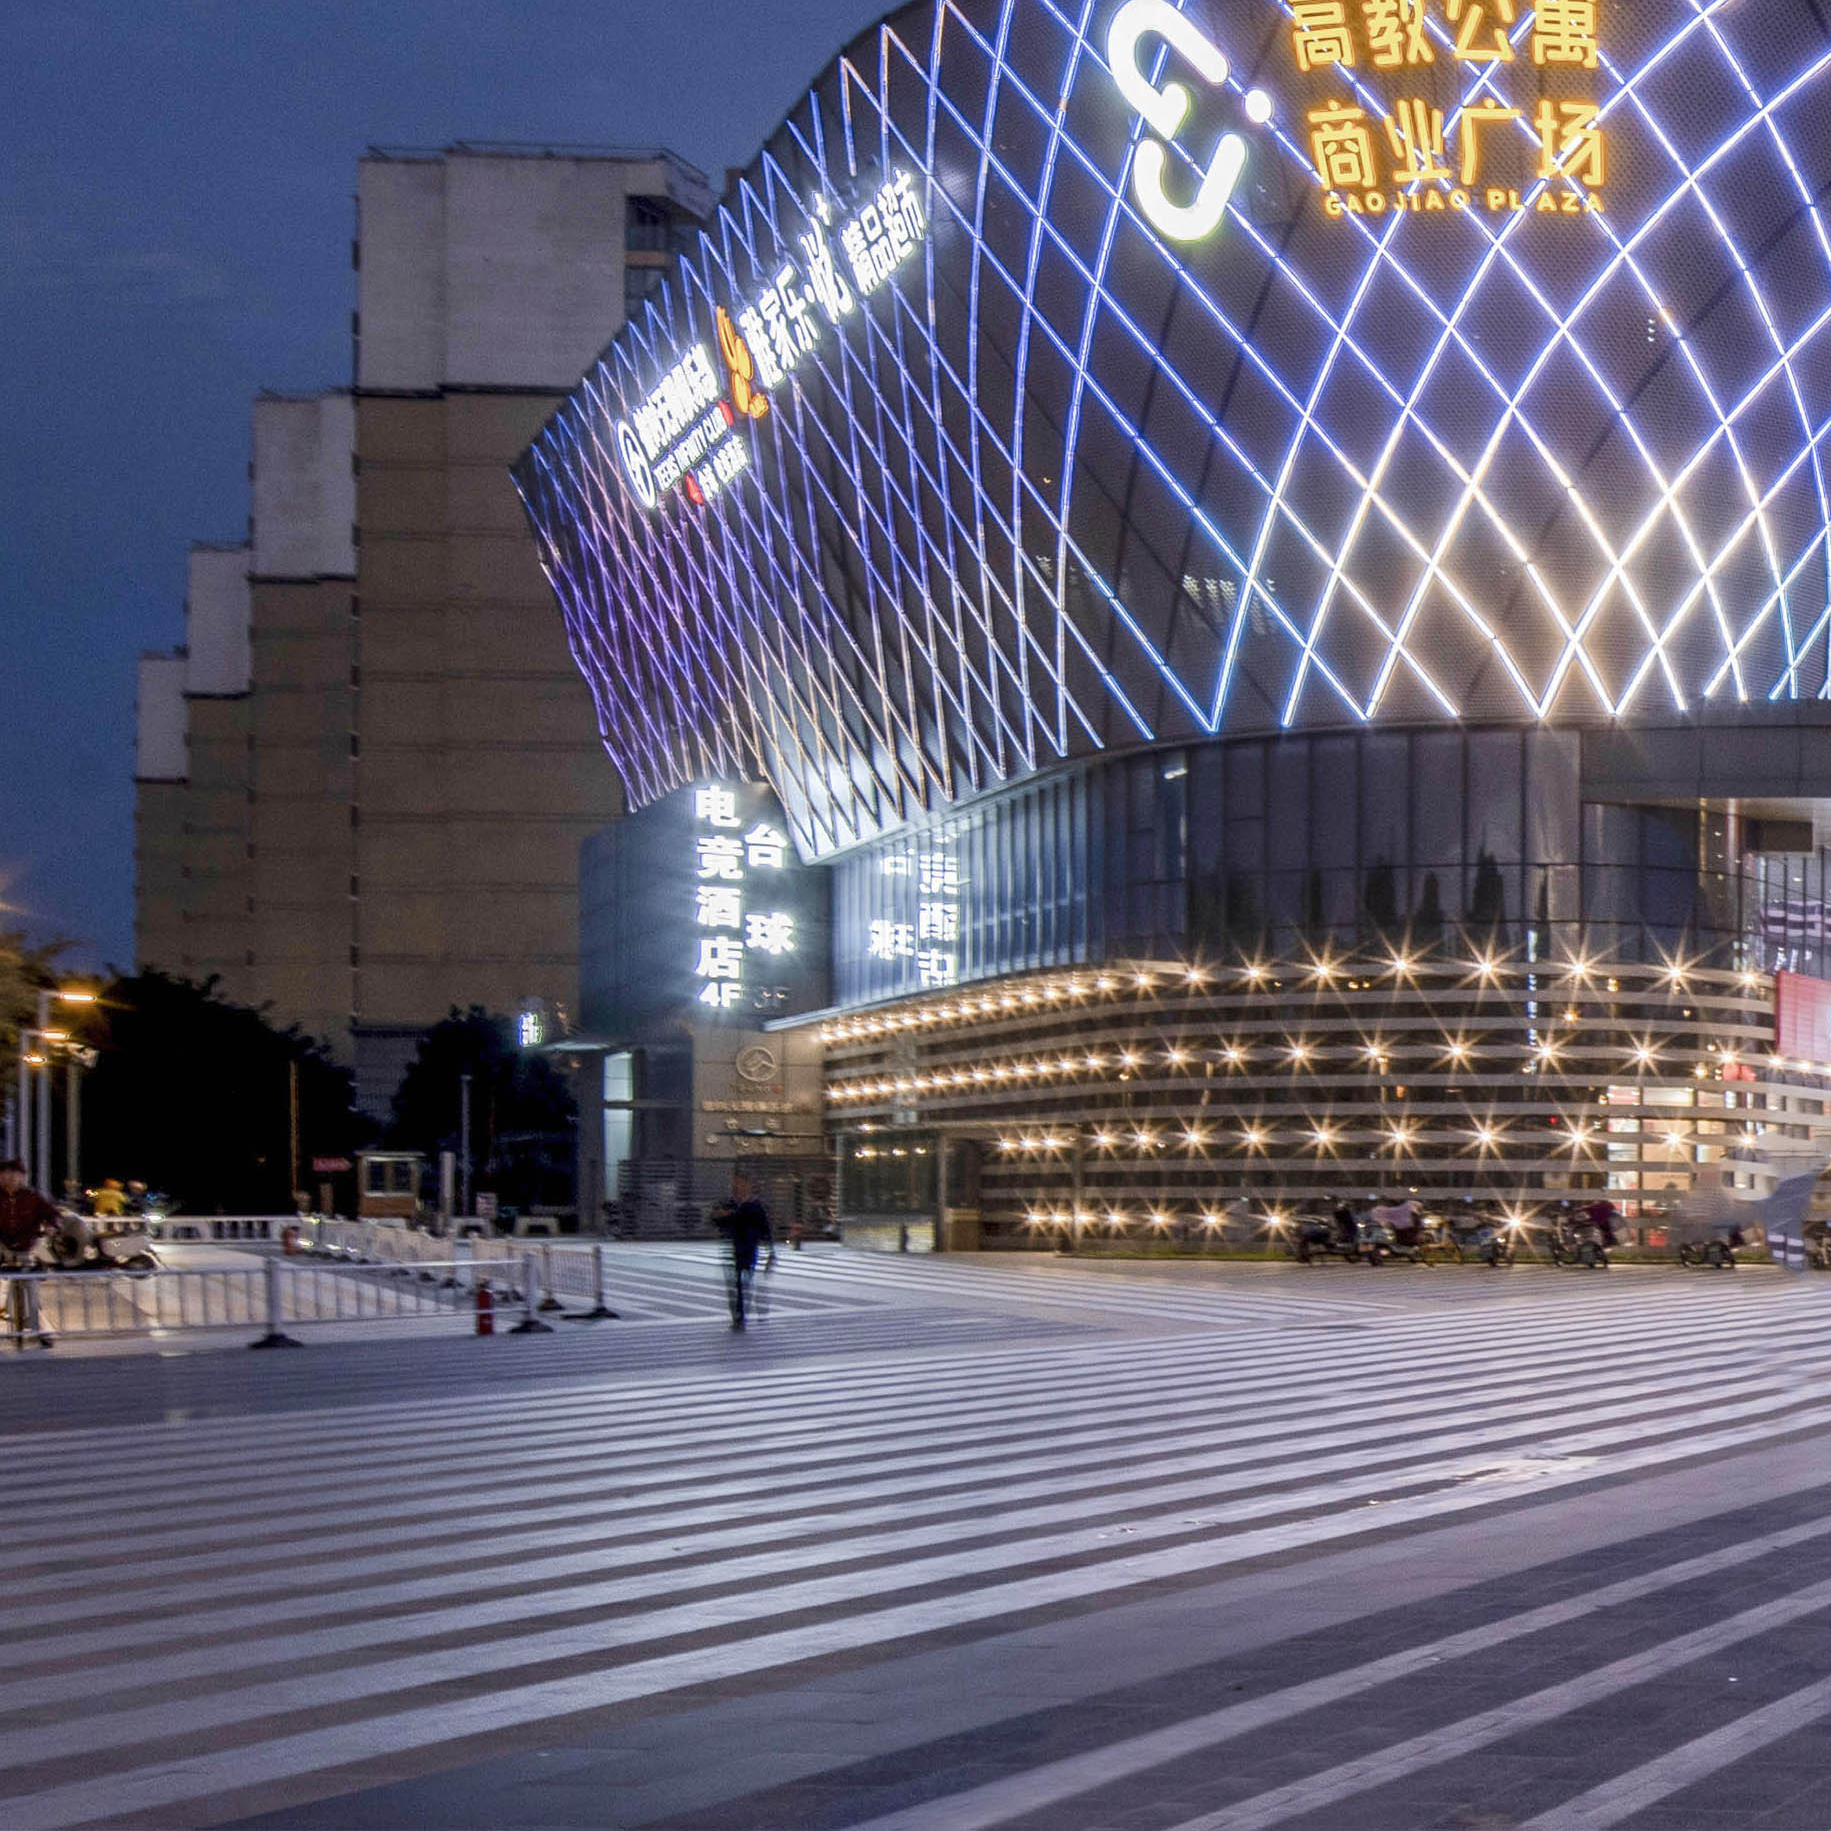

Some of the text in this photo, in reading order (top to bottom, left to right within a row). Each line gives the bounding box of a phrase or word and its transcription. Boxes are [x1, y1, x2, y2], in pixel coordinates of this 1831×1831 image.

[1307, 97, 1605, 190] 商业广场
[1323, 188, 1606, 217] GAOJIAO PLAZA
[694, 785, 745, 980] 电竞酒店
[745, 823, 797, 955] 台球
[699, 981, 744, 1009] 4F
